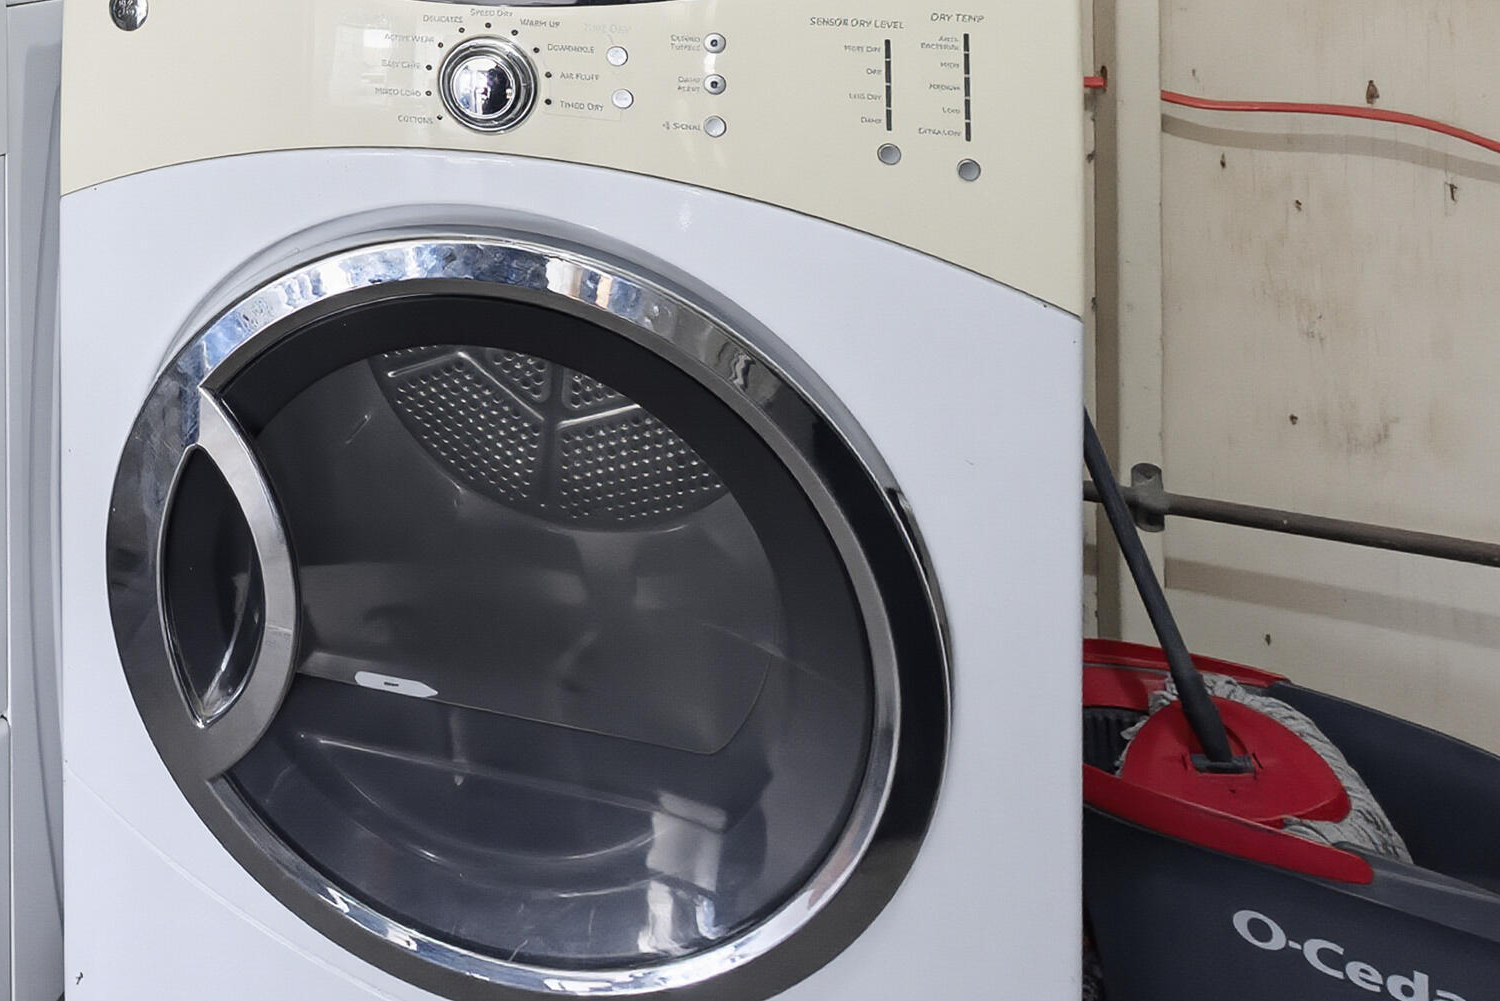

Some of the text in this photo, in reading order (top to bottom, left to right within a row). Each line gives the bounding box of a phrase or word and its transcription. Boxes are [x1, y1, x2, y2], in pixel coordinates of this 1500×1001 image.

[422, 14, 464, 24] DELICATES
[519, 18, 561, 28] WARM UP
[809, 16, 905, 30] SENSOR DRY LEVEL
[930, 12, 985, 23] DRY TEMP
[559, 71, 575, 80] AIR
[559, 100, 605, 112] TIMED DRY
[1232, 909, 1467, 1001] O-Ced
